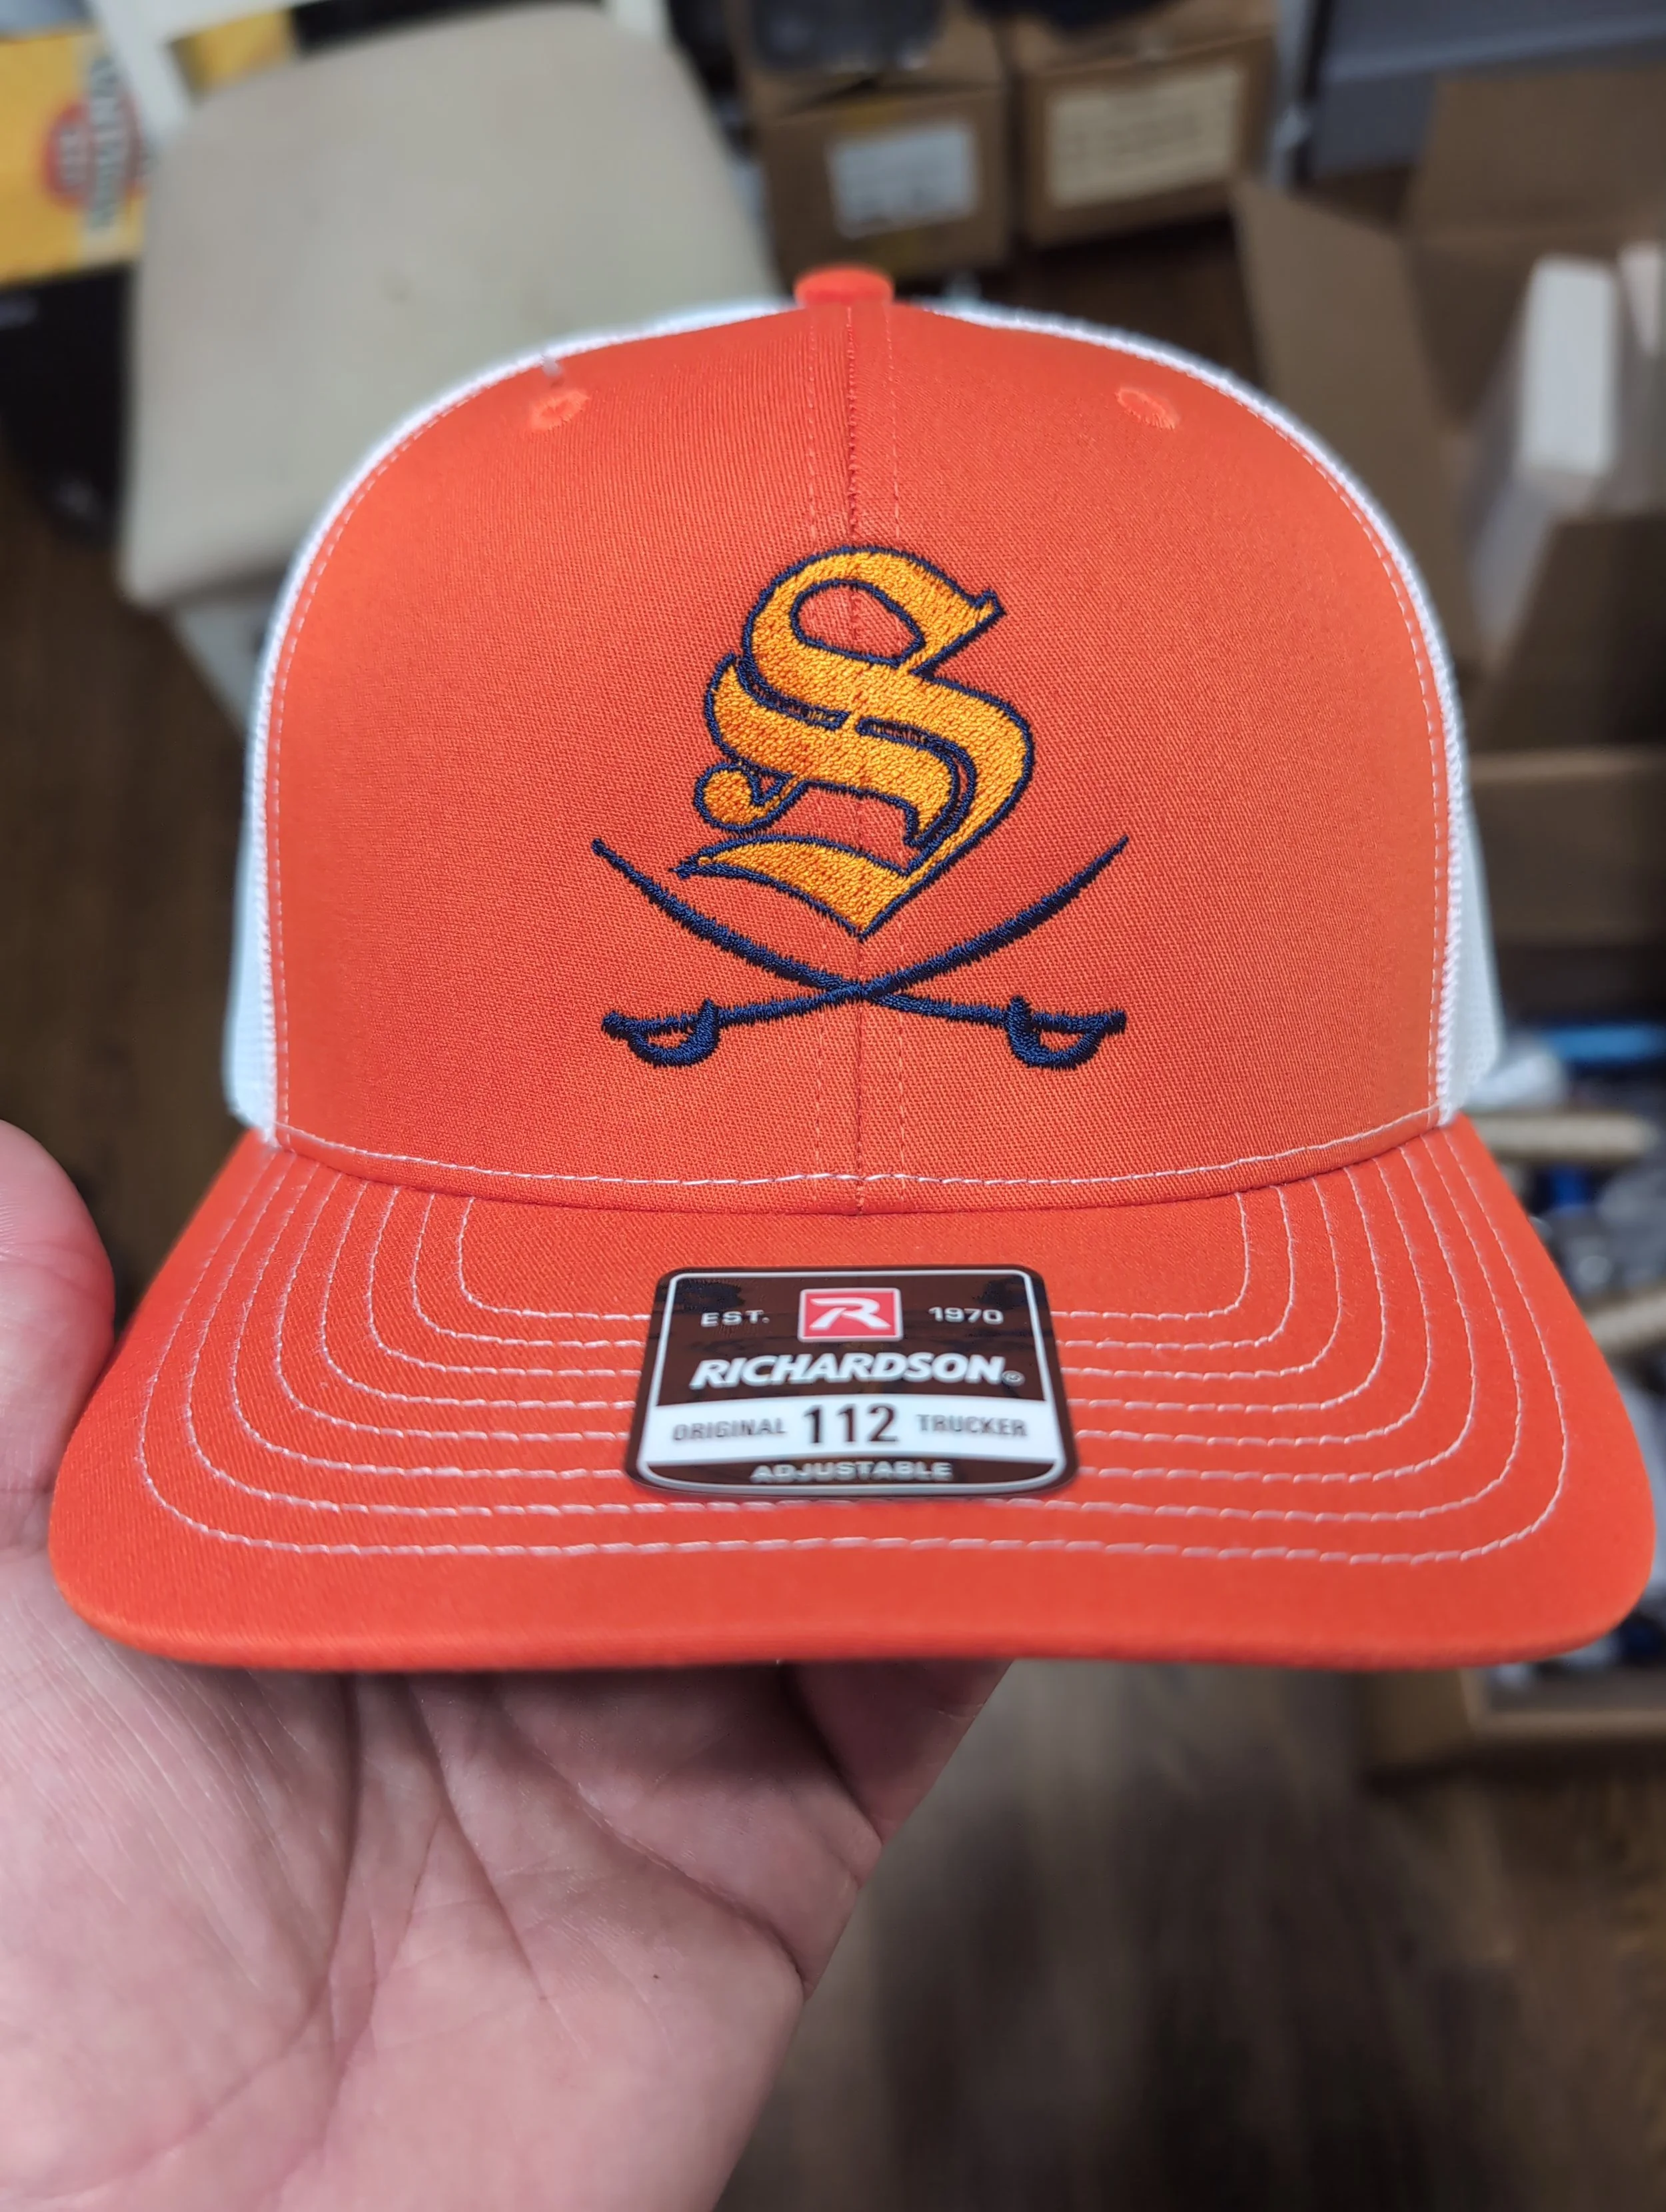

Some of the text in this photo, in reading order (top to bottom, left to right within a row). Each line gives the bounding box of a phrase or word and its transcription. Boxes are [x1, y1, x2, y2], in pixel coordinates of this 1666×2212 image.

[669, 545, 1034, 940] S
[700, 1310, 770, 1327] EST.
[808, 1295, 892, 1331] R
[928, 1306, 1004, 1325] 1970
[672, 1402, 1028, 1444] ORIGINAL 112 TRUCKER
[750, 1460, 954, 1484] ADJUSTABLE
